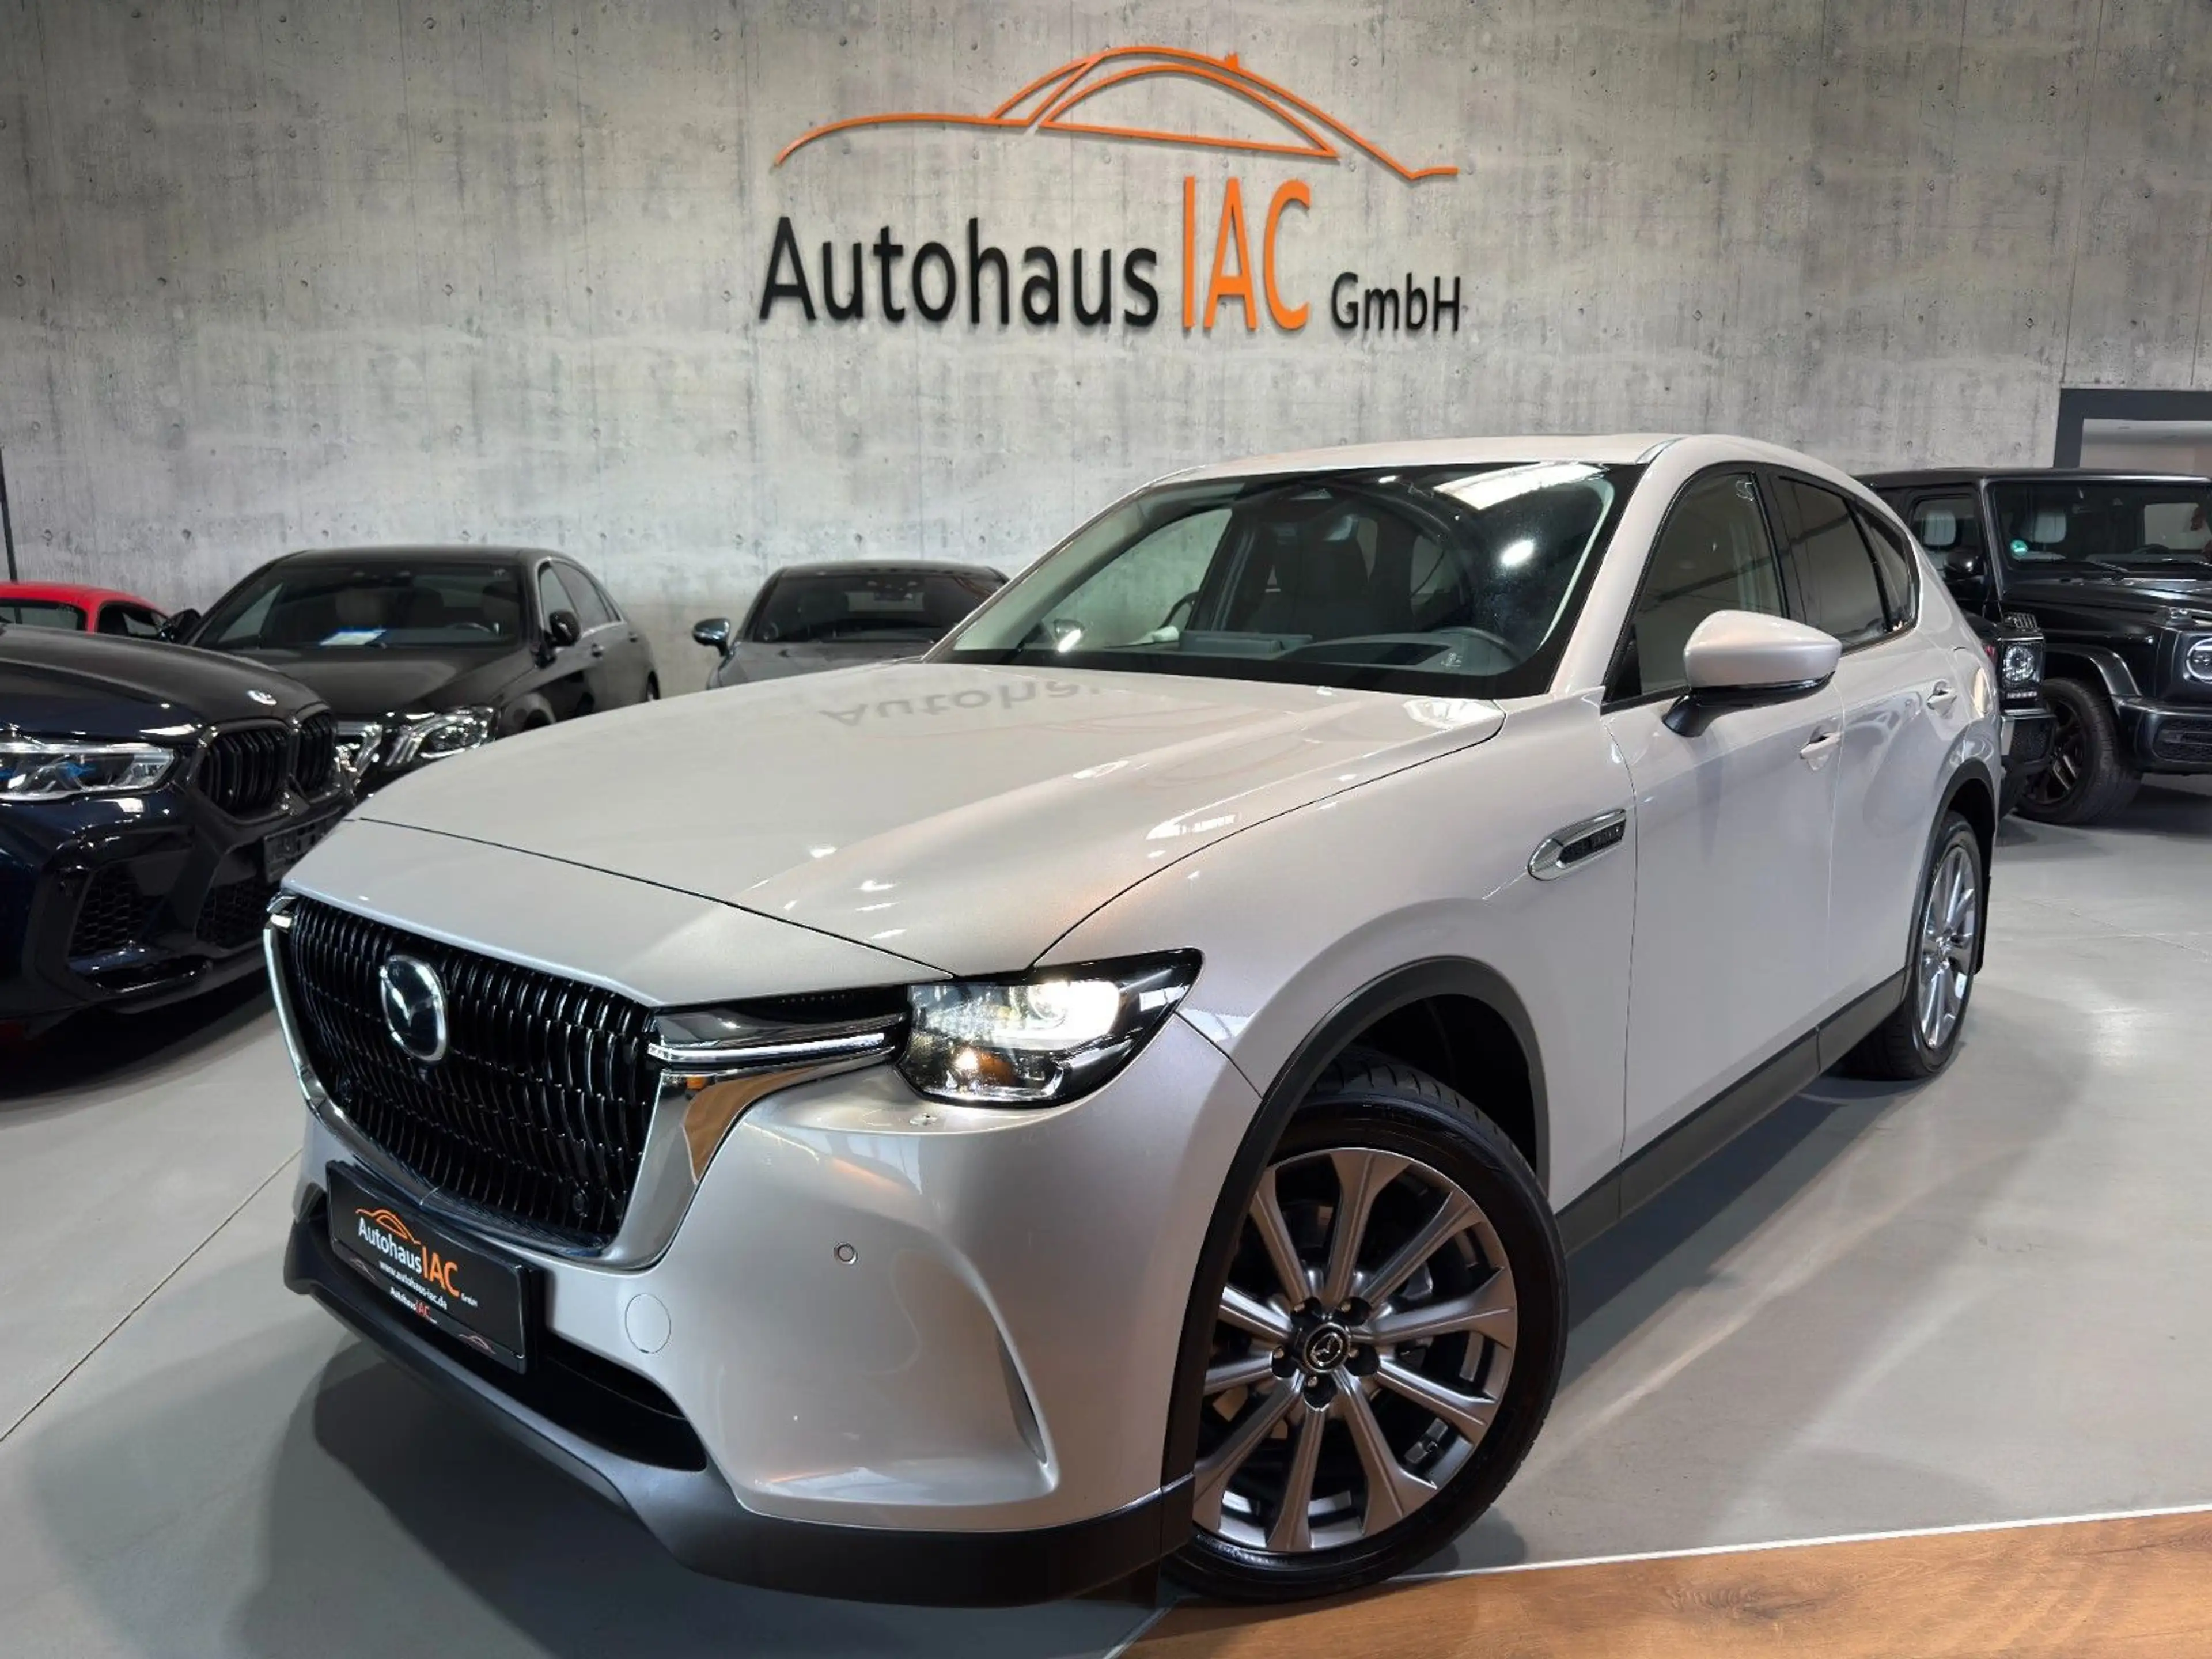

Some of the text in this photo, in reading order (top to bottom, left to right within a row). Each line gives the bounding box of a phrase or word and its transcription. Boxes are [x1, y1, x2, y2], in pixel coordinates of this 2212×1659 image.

[759, 175, 1461, 332] Autohaus IAC GmbH
[358, 1217, 422, 1274] Autohaus
[422, 1246, 460, 1297] IAC
